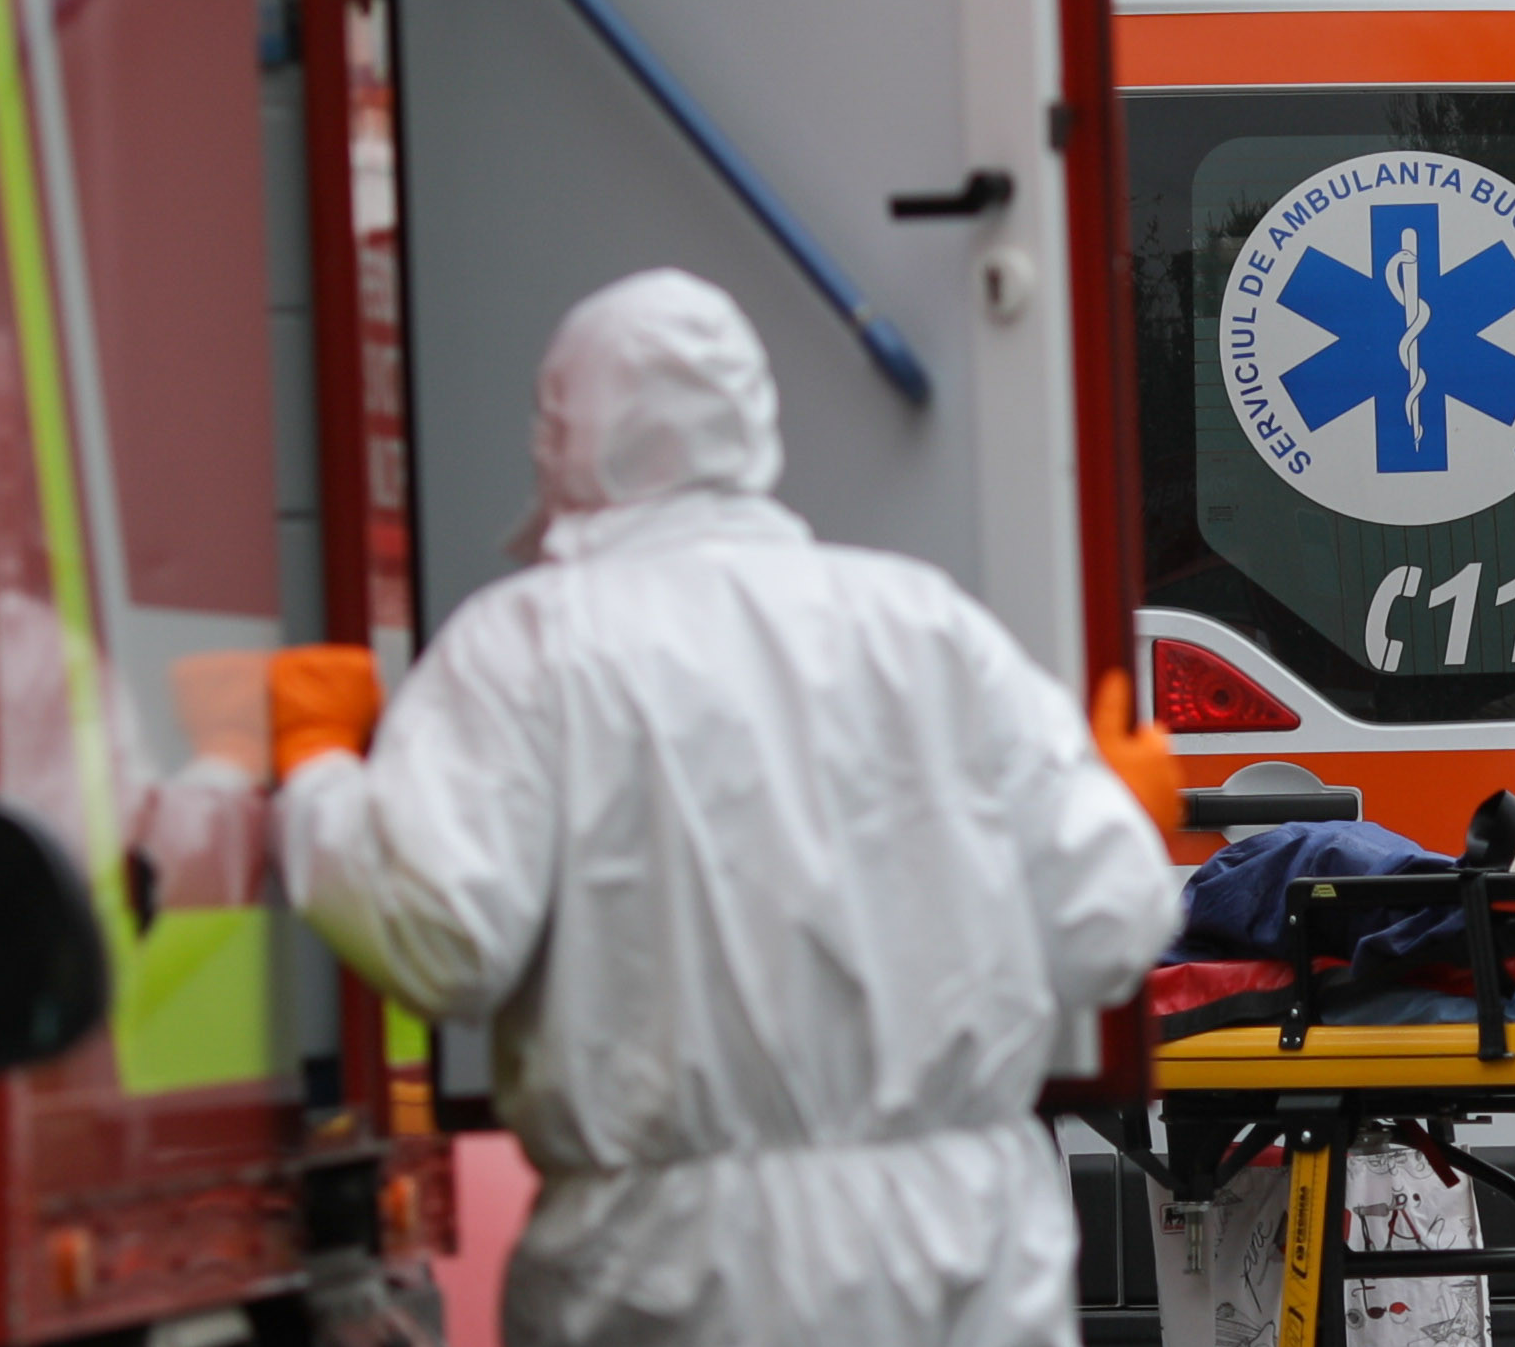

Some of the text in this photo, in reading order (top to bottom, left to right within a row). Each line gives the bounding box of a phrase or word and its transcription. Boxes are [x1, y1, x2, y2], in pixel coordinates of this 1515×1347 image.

[1268, 161, 1462, 251] AMBULANTA
[1237, 250, 1276, 297] DE
[1231, 306, 1312, 475] SERVICIUL
